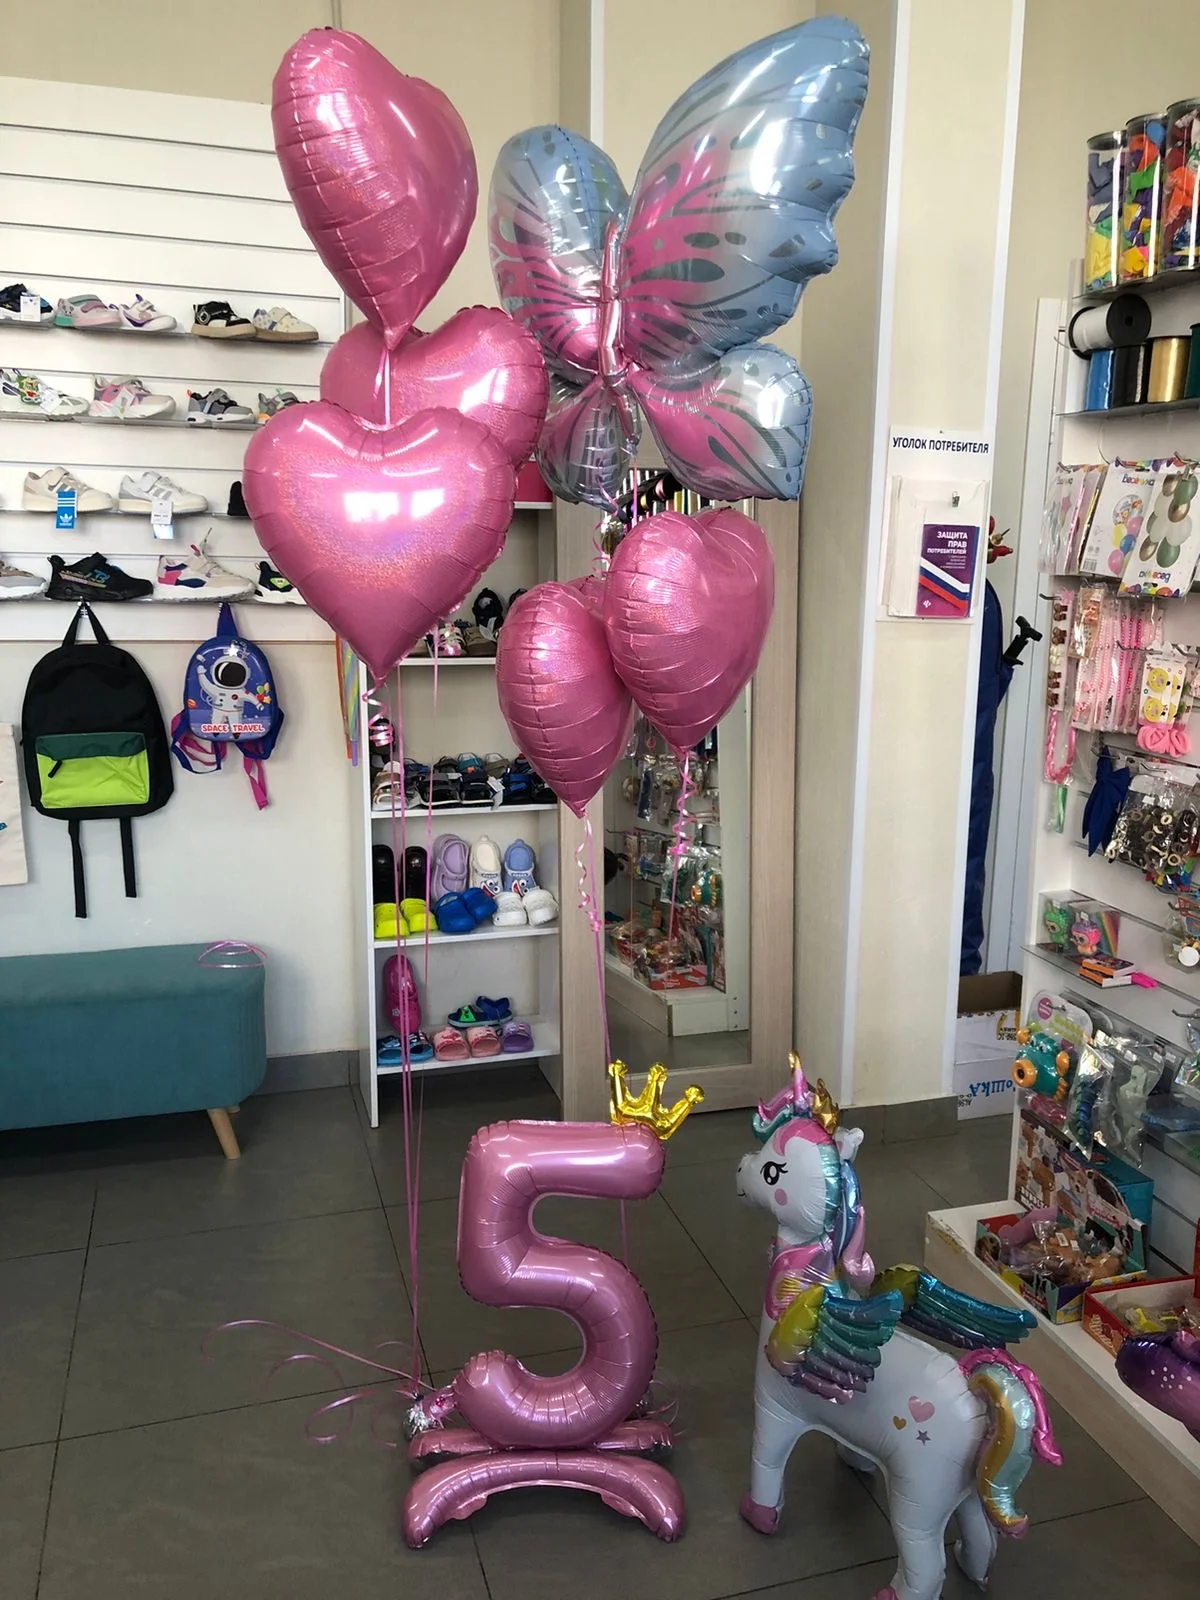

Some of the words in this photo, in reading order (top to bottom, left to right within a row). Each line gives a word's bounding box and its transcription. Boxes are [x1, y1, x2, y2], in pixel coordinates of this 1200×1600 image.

[892, 436, 927, 449] УГОЛОК
[928, 439, 989, 453] ПОТРЕБИТЕЛЯ
[937, 531, 968, 540] ЗАЩИТА
[948, 540, 967, 548] ПРАВ
[201, 723, 229, 732] SPACE
[232, 723, 265, 733] TRAVEL
[457, 1119, 667, 1450] 5
